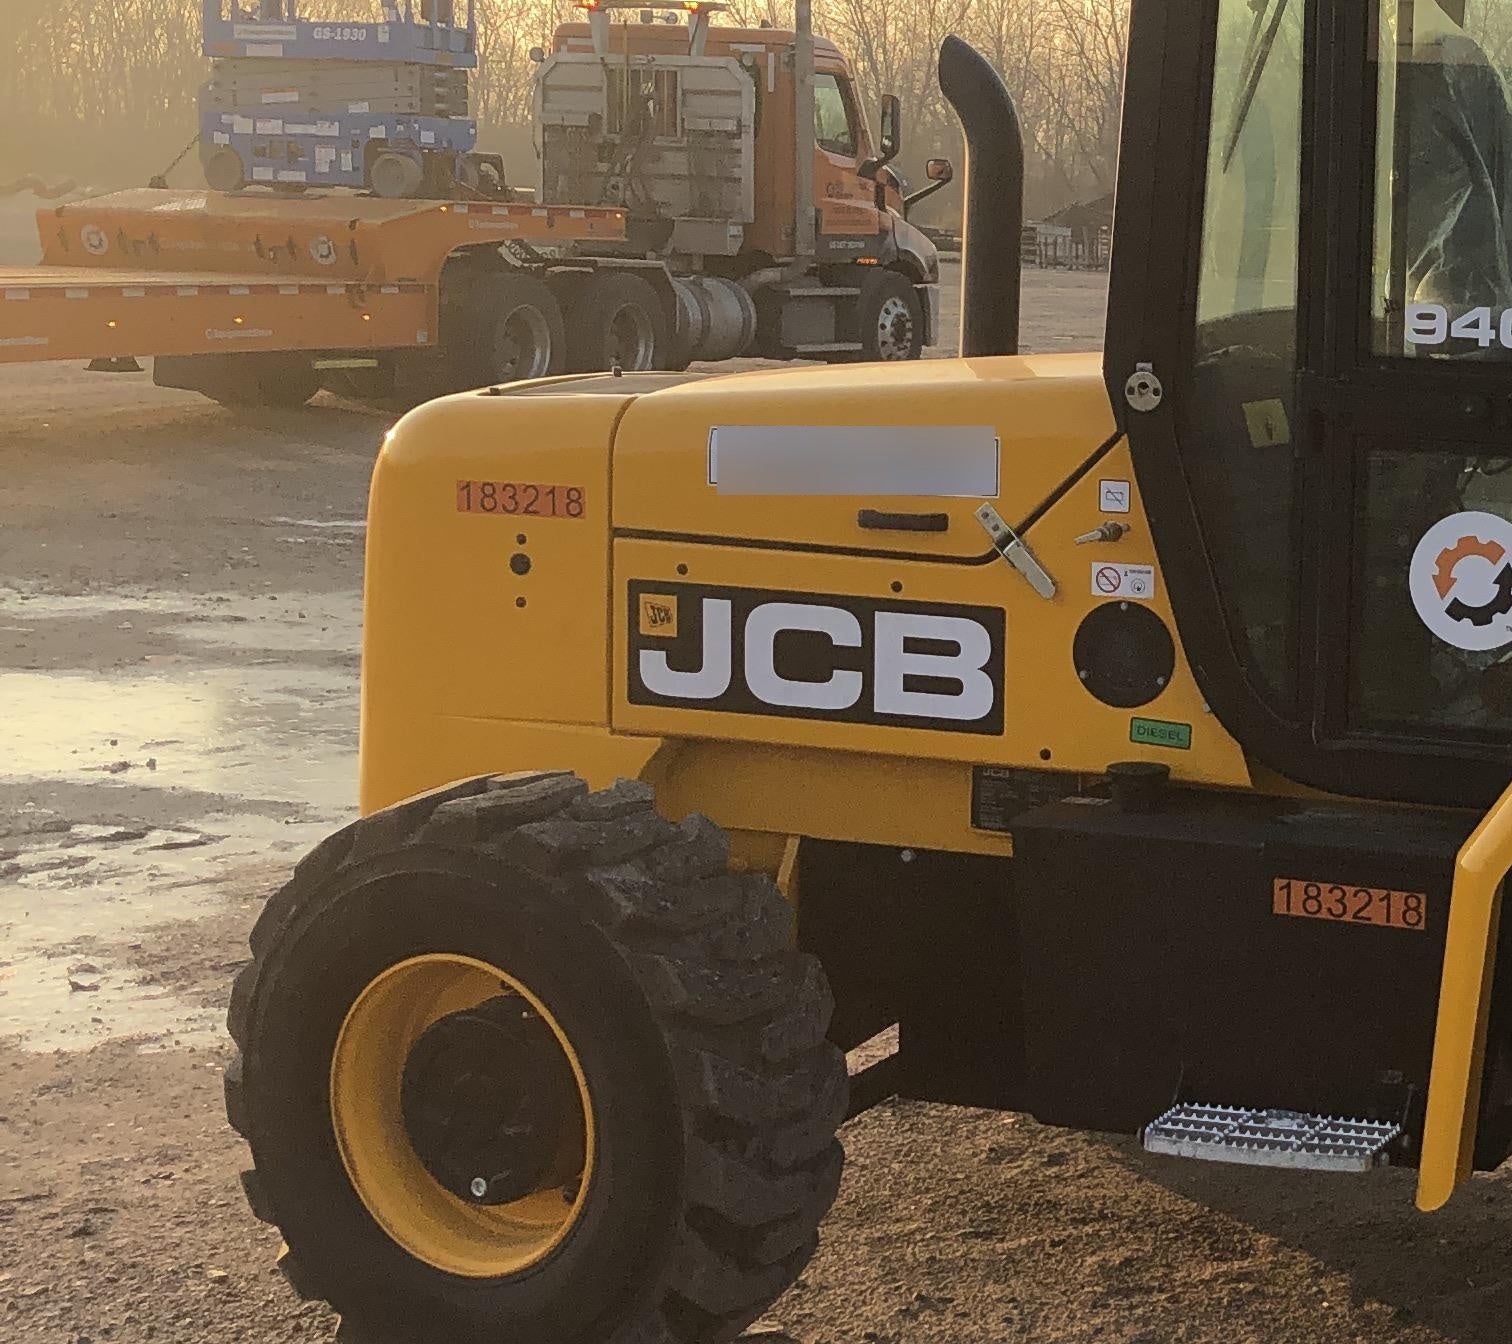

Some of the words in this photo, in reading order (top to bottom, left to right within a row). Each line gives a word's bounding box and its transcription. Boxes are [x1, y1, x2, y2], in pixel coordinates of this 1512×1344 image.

[313, 26, 367, 41] GS-1930
[459, 481, 584, 517] 183218
[639, 596, 995, 720] JCB
[1136, 724, 1183, 742] DIESEL
[1277, 880, 1424, 929] 183218
